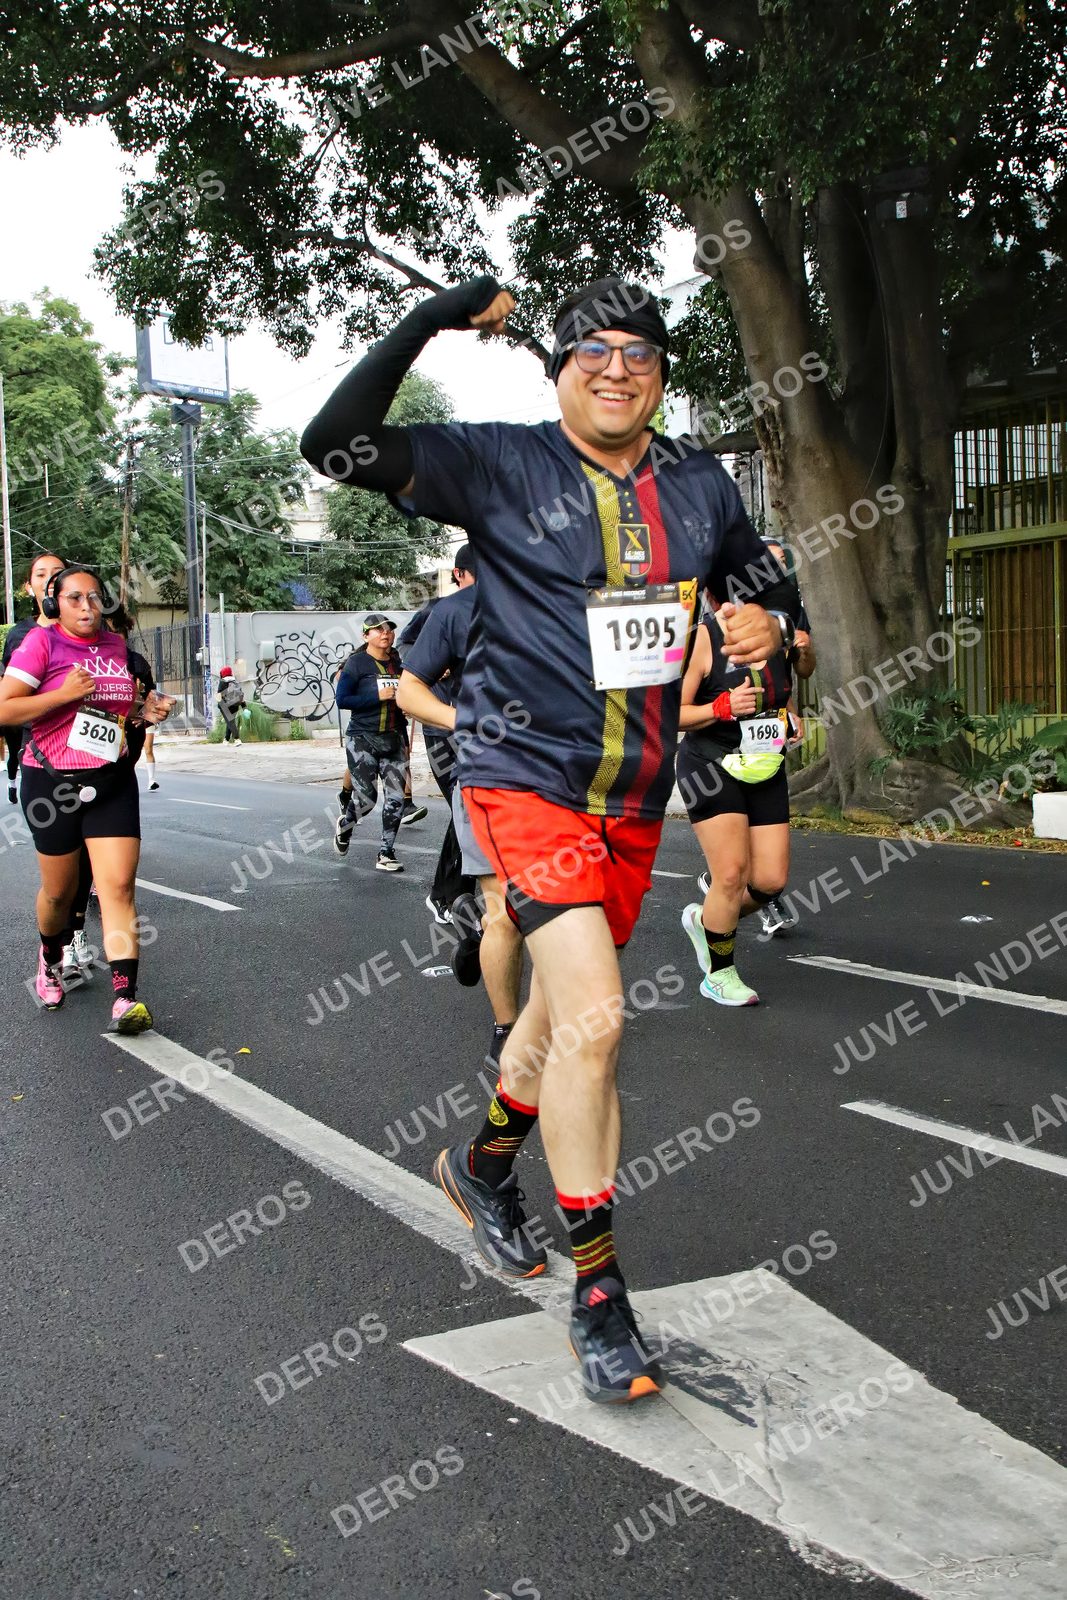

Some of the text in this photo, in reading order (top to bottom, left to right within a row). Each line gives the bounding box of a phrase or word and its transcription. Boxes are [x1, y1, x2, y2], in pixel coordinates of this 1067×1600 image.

[275, 630, 316, 646] TOY
[606, 616, 676, 651] 1995
[95, 683, 133, 693] UJERES
[83, 693, 133, 702] RUNNERAS
[79, 720, 116, 744] 3620
[748, 724, 779, 741] 1698
